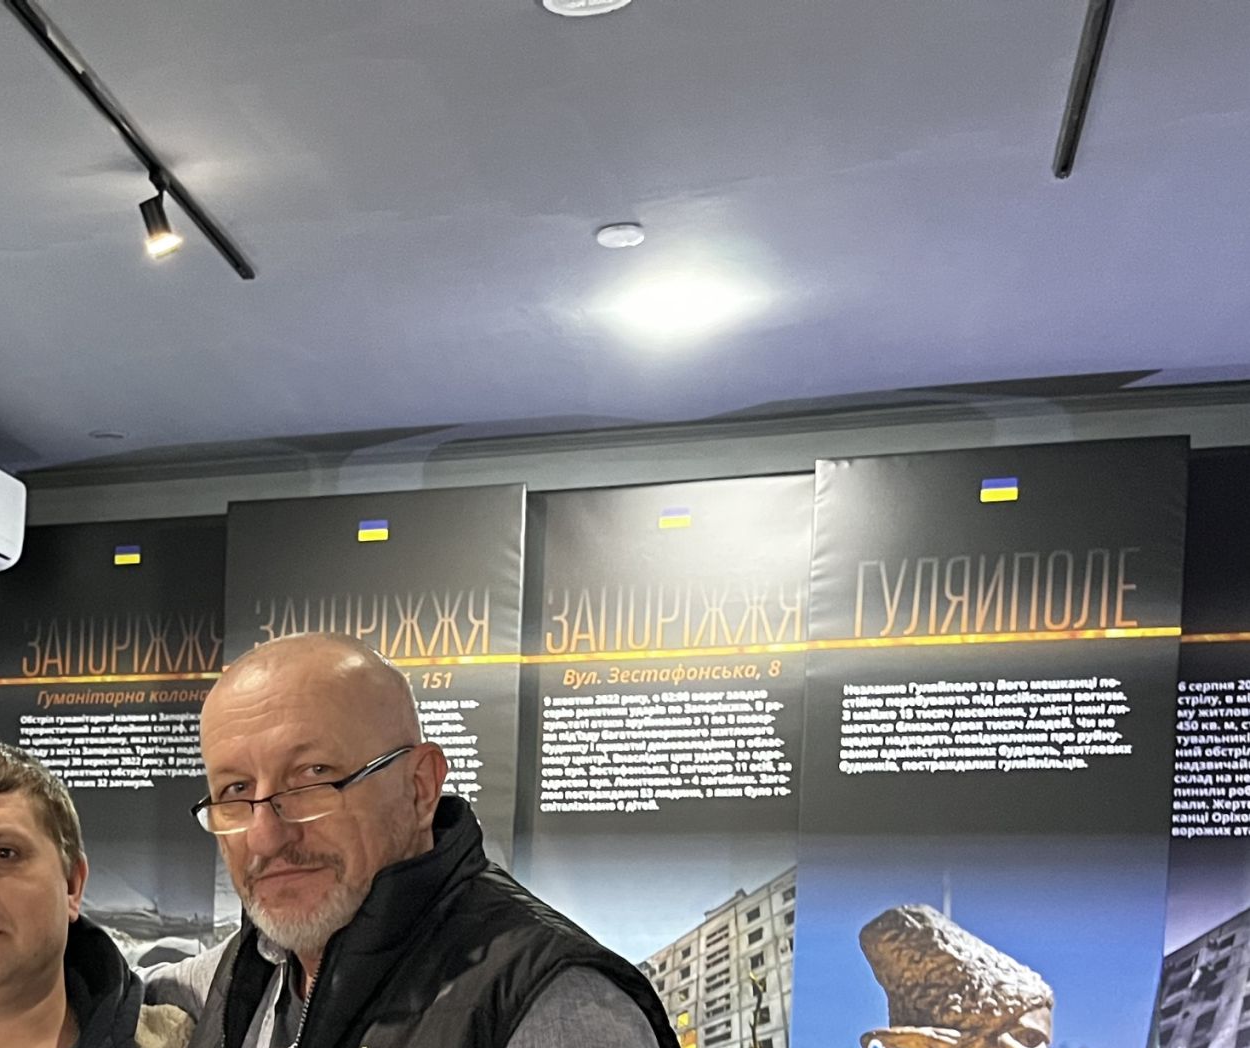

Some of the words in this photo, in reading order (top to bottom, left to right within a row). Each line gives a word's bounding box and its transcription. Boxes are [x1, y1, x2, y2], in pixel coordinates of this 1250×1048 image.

[422, 672, 453, 689] 151
[563, 669, 602, 690] Вул.
[607, 663, 761, 685] Зестафонська,
[768, 660, 781, 677] 8
[908, 681, 978, 695] Гуляйполе
[979, 681, 995, 691] та
[996, 679, 1028, 692] його
[1029, 677, 1097, 689] мешканці
[1178, 681, 1186, 691] 6
[1188, 682, 1235, 693] серпня
[37, 689, 145, 709] Гуманітарна
[971, 693, 993, 706] під
[994, 692, 1072, 705] російським
[1074, 691, 1127, 702] вогнем.
[1177, 694, 1222, 706] стрілу,
[1225, 695, 1233, 703] в
[1177, 709, 1195, 720] му
[1198, 708, 1250, 717] житлов
[1176, 720, 1199, 731] 450
[1201, 721, 1221, 730] кв.
[1224, 721, 1238, 731] м,
[1050, 732, 1075, 744] про
[1063, 744, 1132, 755] житлових
[1175, 746, 1202, 757] ний
[1174, 759, 1250, 771] надзвичай
[1174, 774, 1213, 785] склад
[1215, 774, 1232, 783] на
[1173, 787, 1225, 796] пинили
[1173, 801, 1209, 809] вали.
[1172, 812, 1209, 824] канці
[1211, 812, 1250, 824] Оріхо
[1171, 827, 1231, 837] ворожих
[1233, 826, 1250, 835] ат
